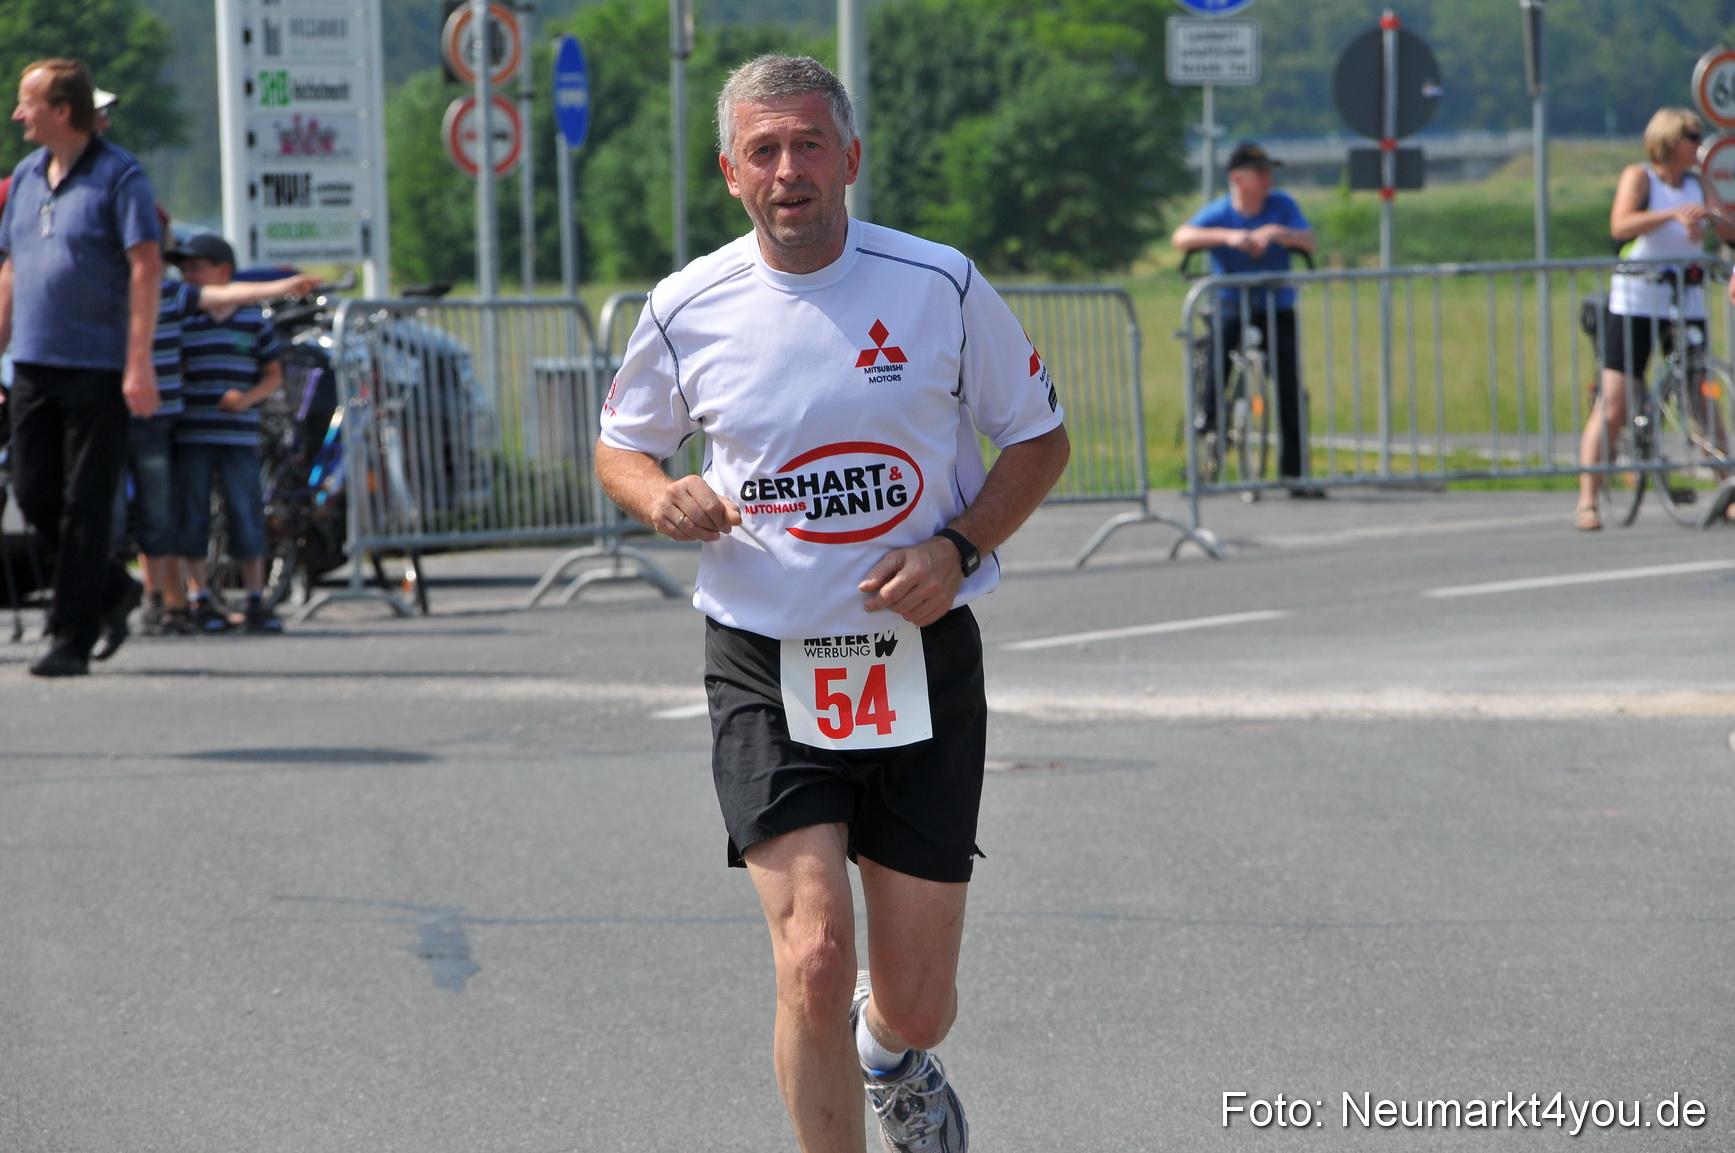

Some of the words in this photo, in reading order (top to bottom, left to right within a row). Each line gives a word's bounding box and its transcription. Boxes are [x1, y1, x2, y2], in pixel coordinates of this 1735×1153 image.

[864, 364, 903, 375] MITSUBISHI
[868, 374, 902, 384] MOTORS
[740, 463, 886, 501] GERHART
[889, 466, 902, 481] &
[745, 501, 807, 515] AUTOHAUS
[805, 484, 908, 520] JÄNIG
[804, 645, 871, 658] WERBUNG
[814, 664, 897, 740] 54
